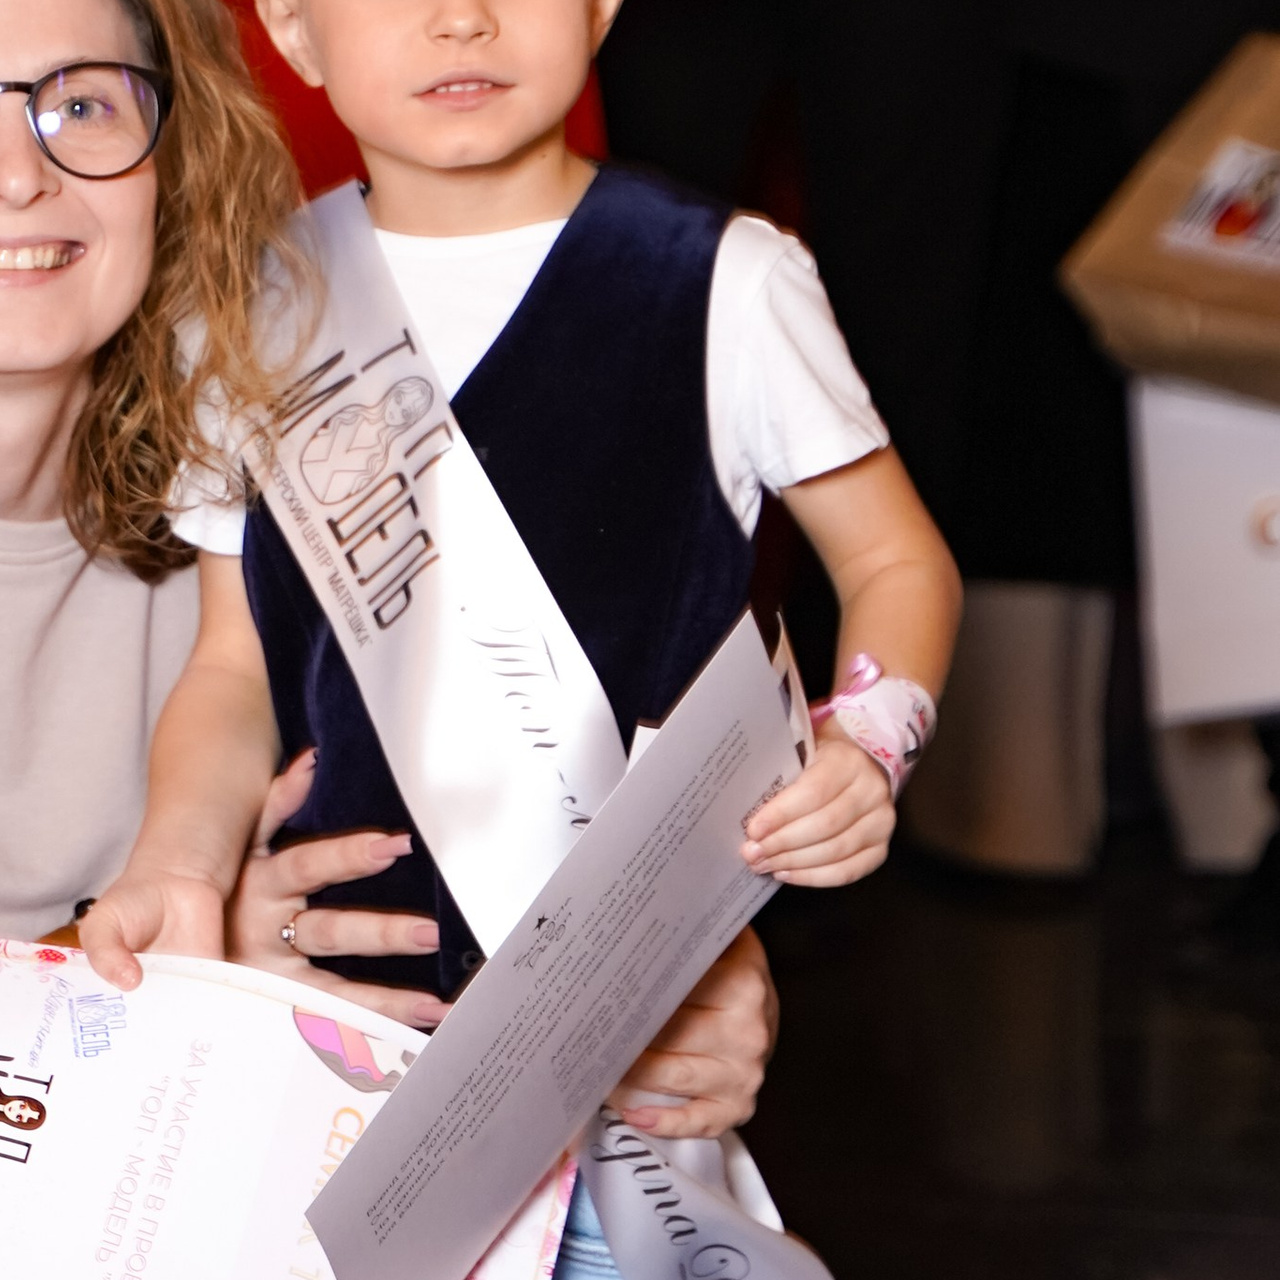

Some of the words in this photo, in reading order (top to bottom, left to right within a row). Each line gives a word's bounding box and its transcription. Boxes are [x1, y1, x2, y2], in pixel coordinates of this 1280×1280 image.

[187, 1039, 212, 1069] ЗА
[159, 1076, 199, 1189] УЧАСТИЕ
[96, 1154, 145, 1266] МОДЕЛЬ
